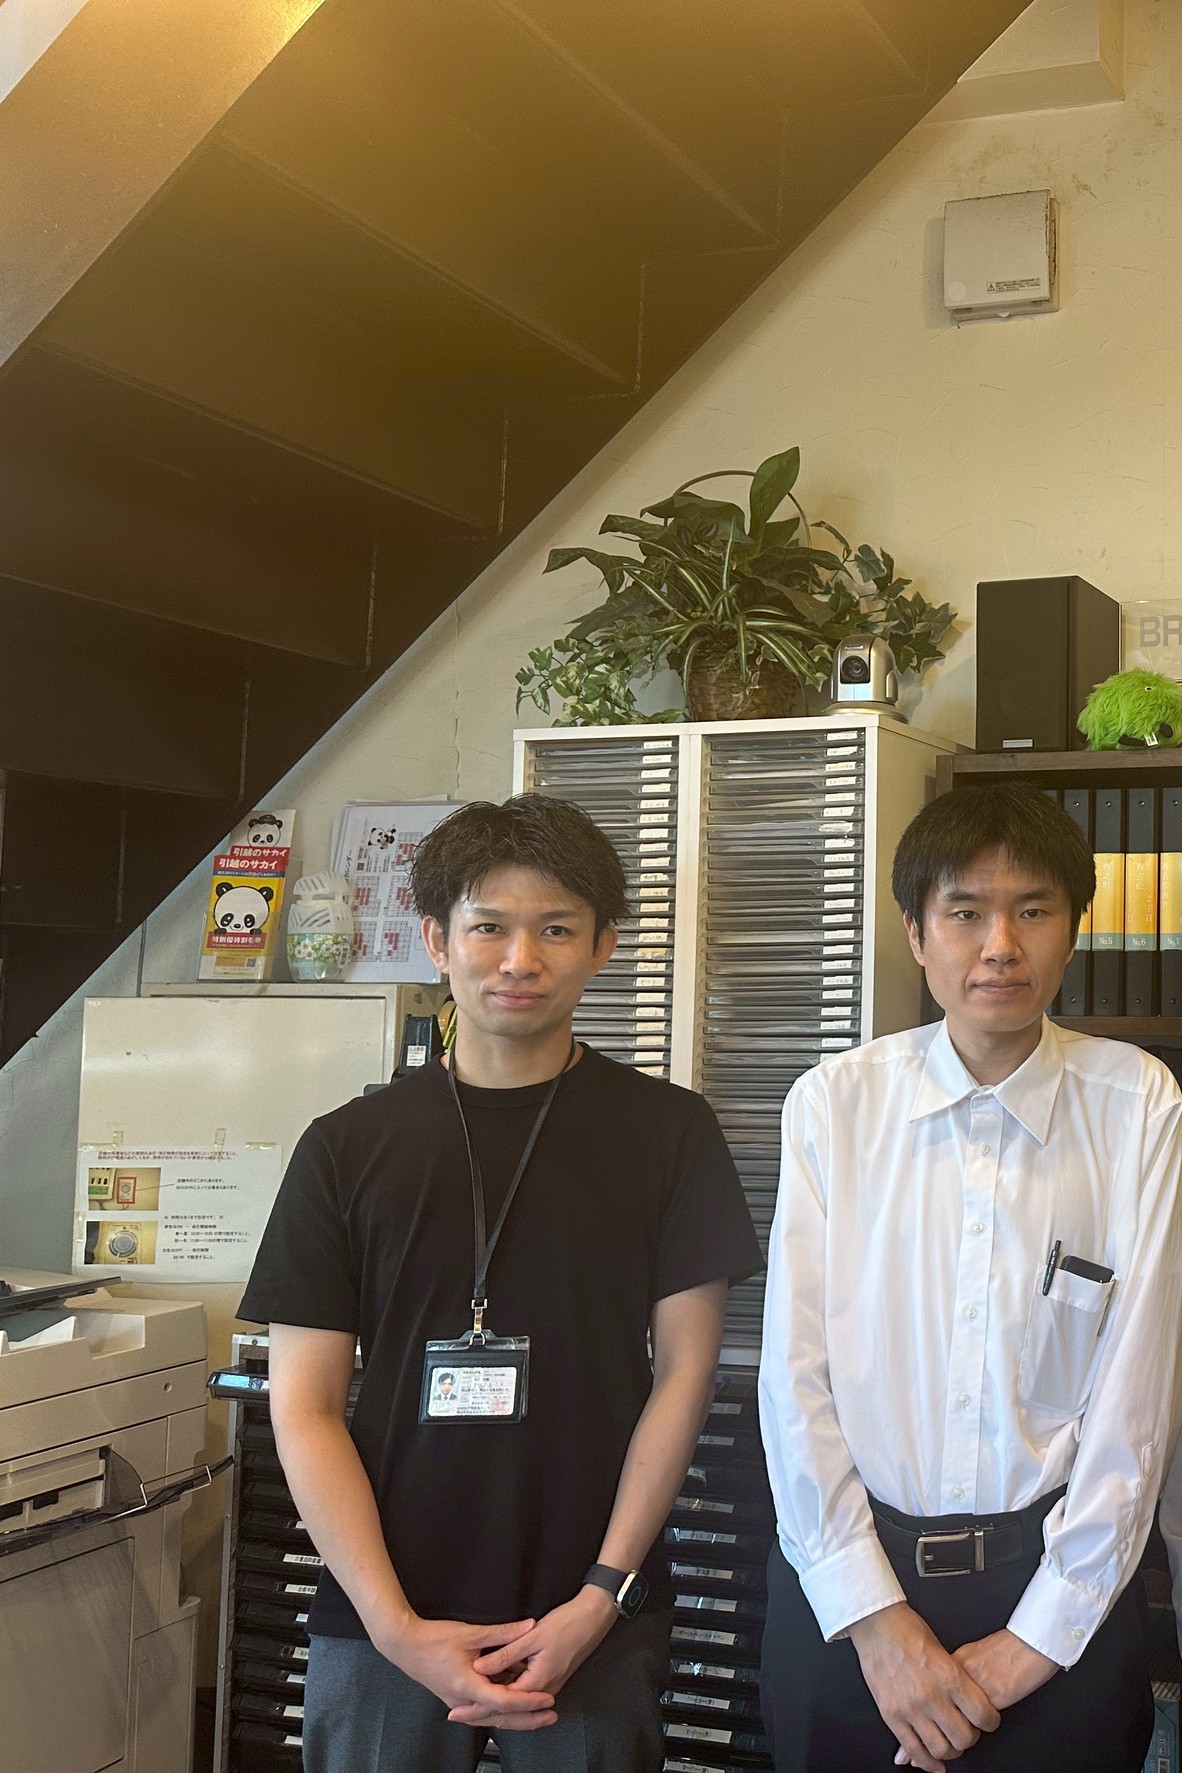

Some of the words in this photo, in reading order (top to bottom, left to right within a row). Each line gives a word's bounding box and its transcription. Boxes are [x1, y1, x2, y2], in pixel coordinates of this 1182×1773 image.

[217, 857, 278, 871] 引越のサカイ
[1099, 936, 1113, 945] No.5
[1132, 938, 1147, 946] No.6
